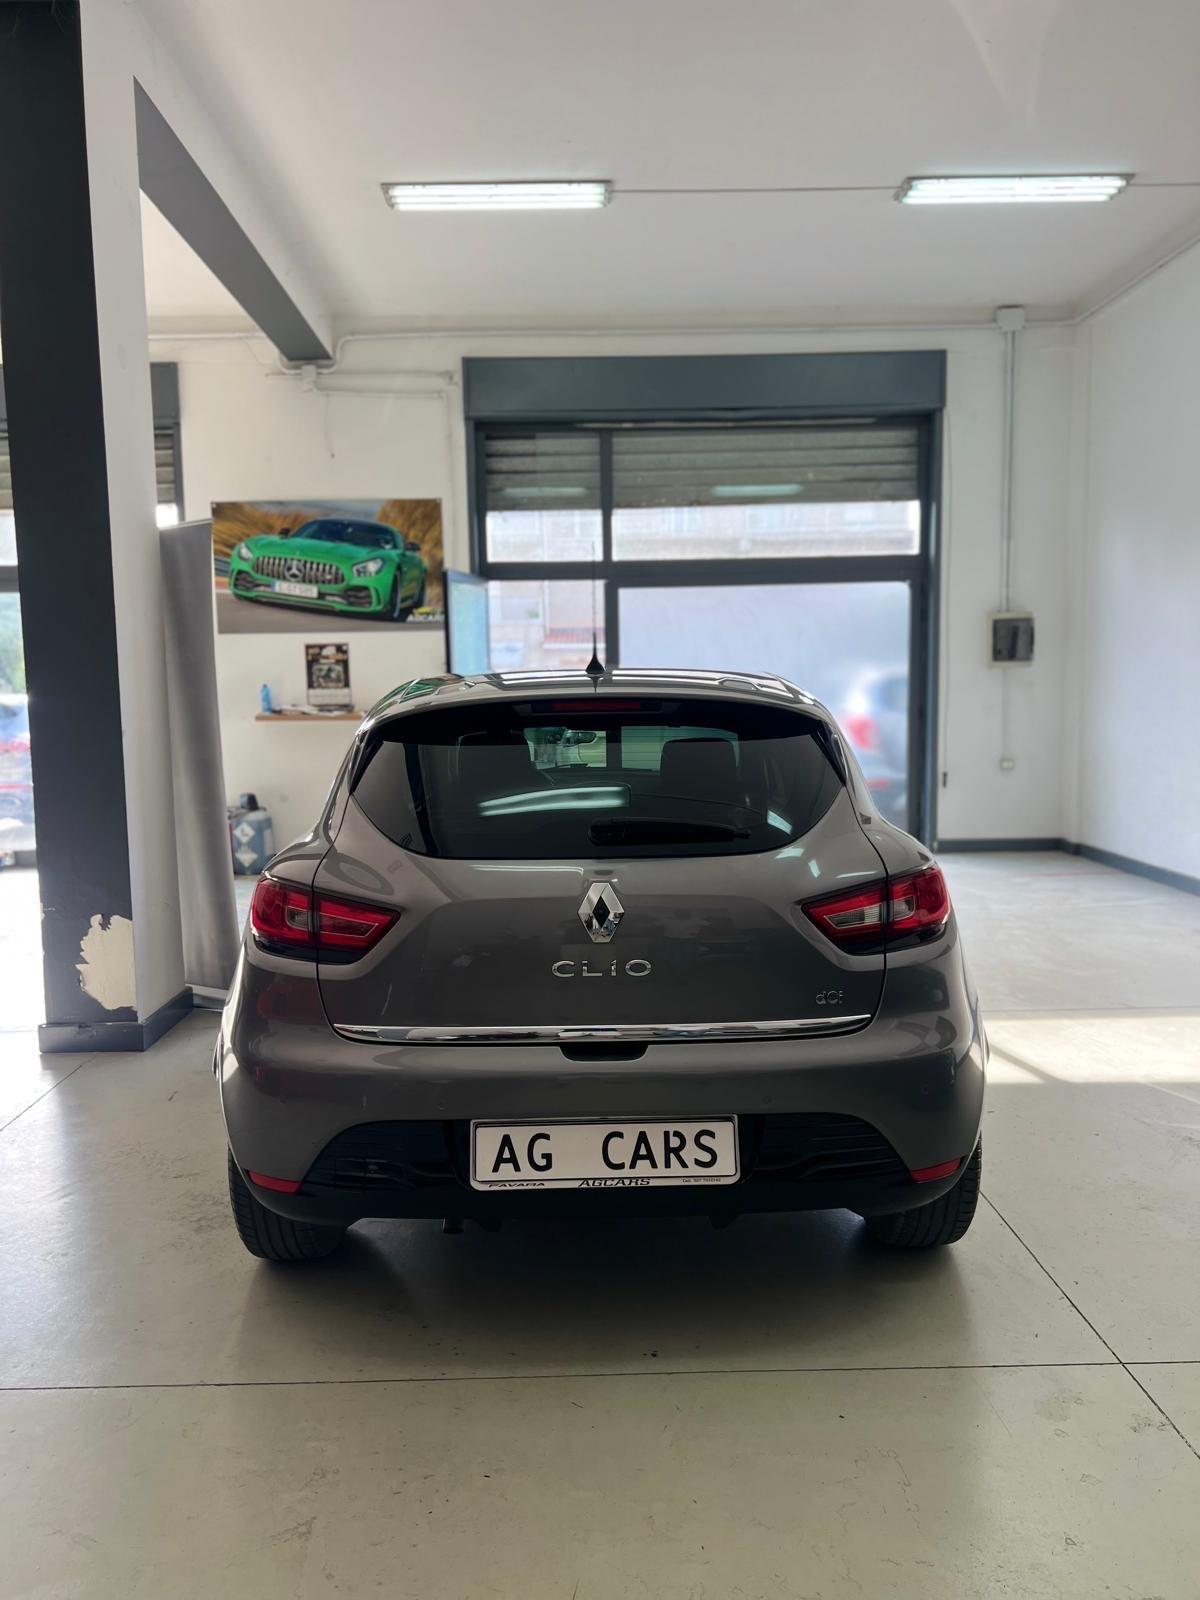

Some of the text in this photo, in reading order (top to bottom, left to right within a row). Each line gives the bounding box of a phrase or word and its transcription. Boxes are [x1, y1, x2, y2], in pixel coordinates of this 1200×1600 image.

[551, 959, 652, 977] CLIO
[815, 990, 844, 1005] dCi
[491, 1129, 718, 1173] AG CARS
[578, 1178, 651, 1187] AGCARS
